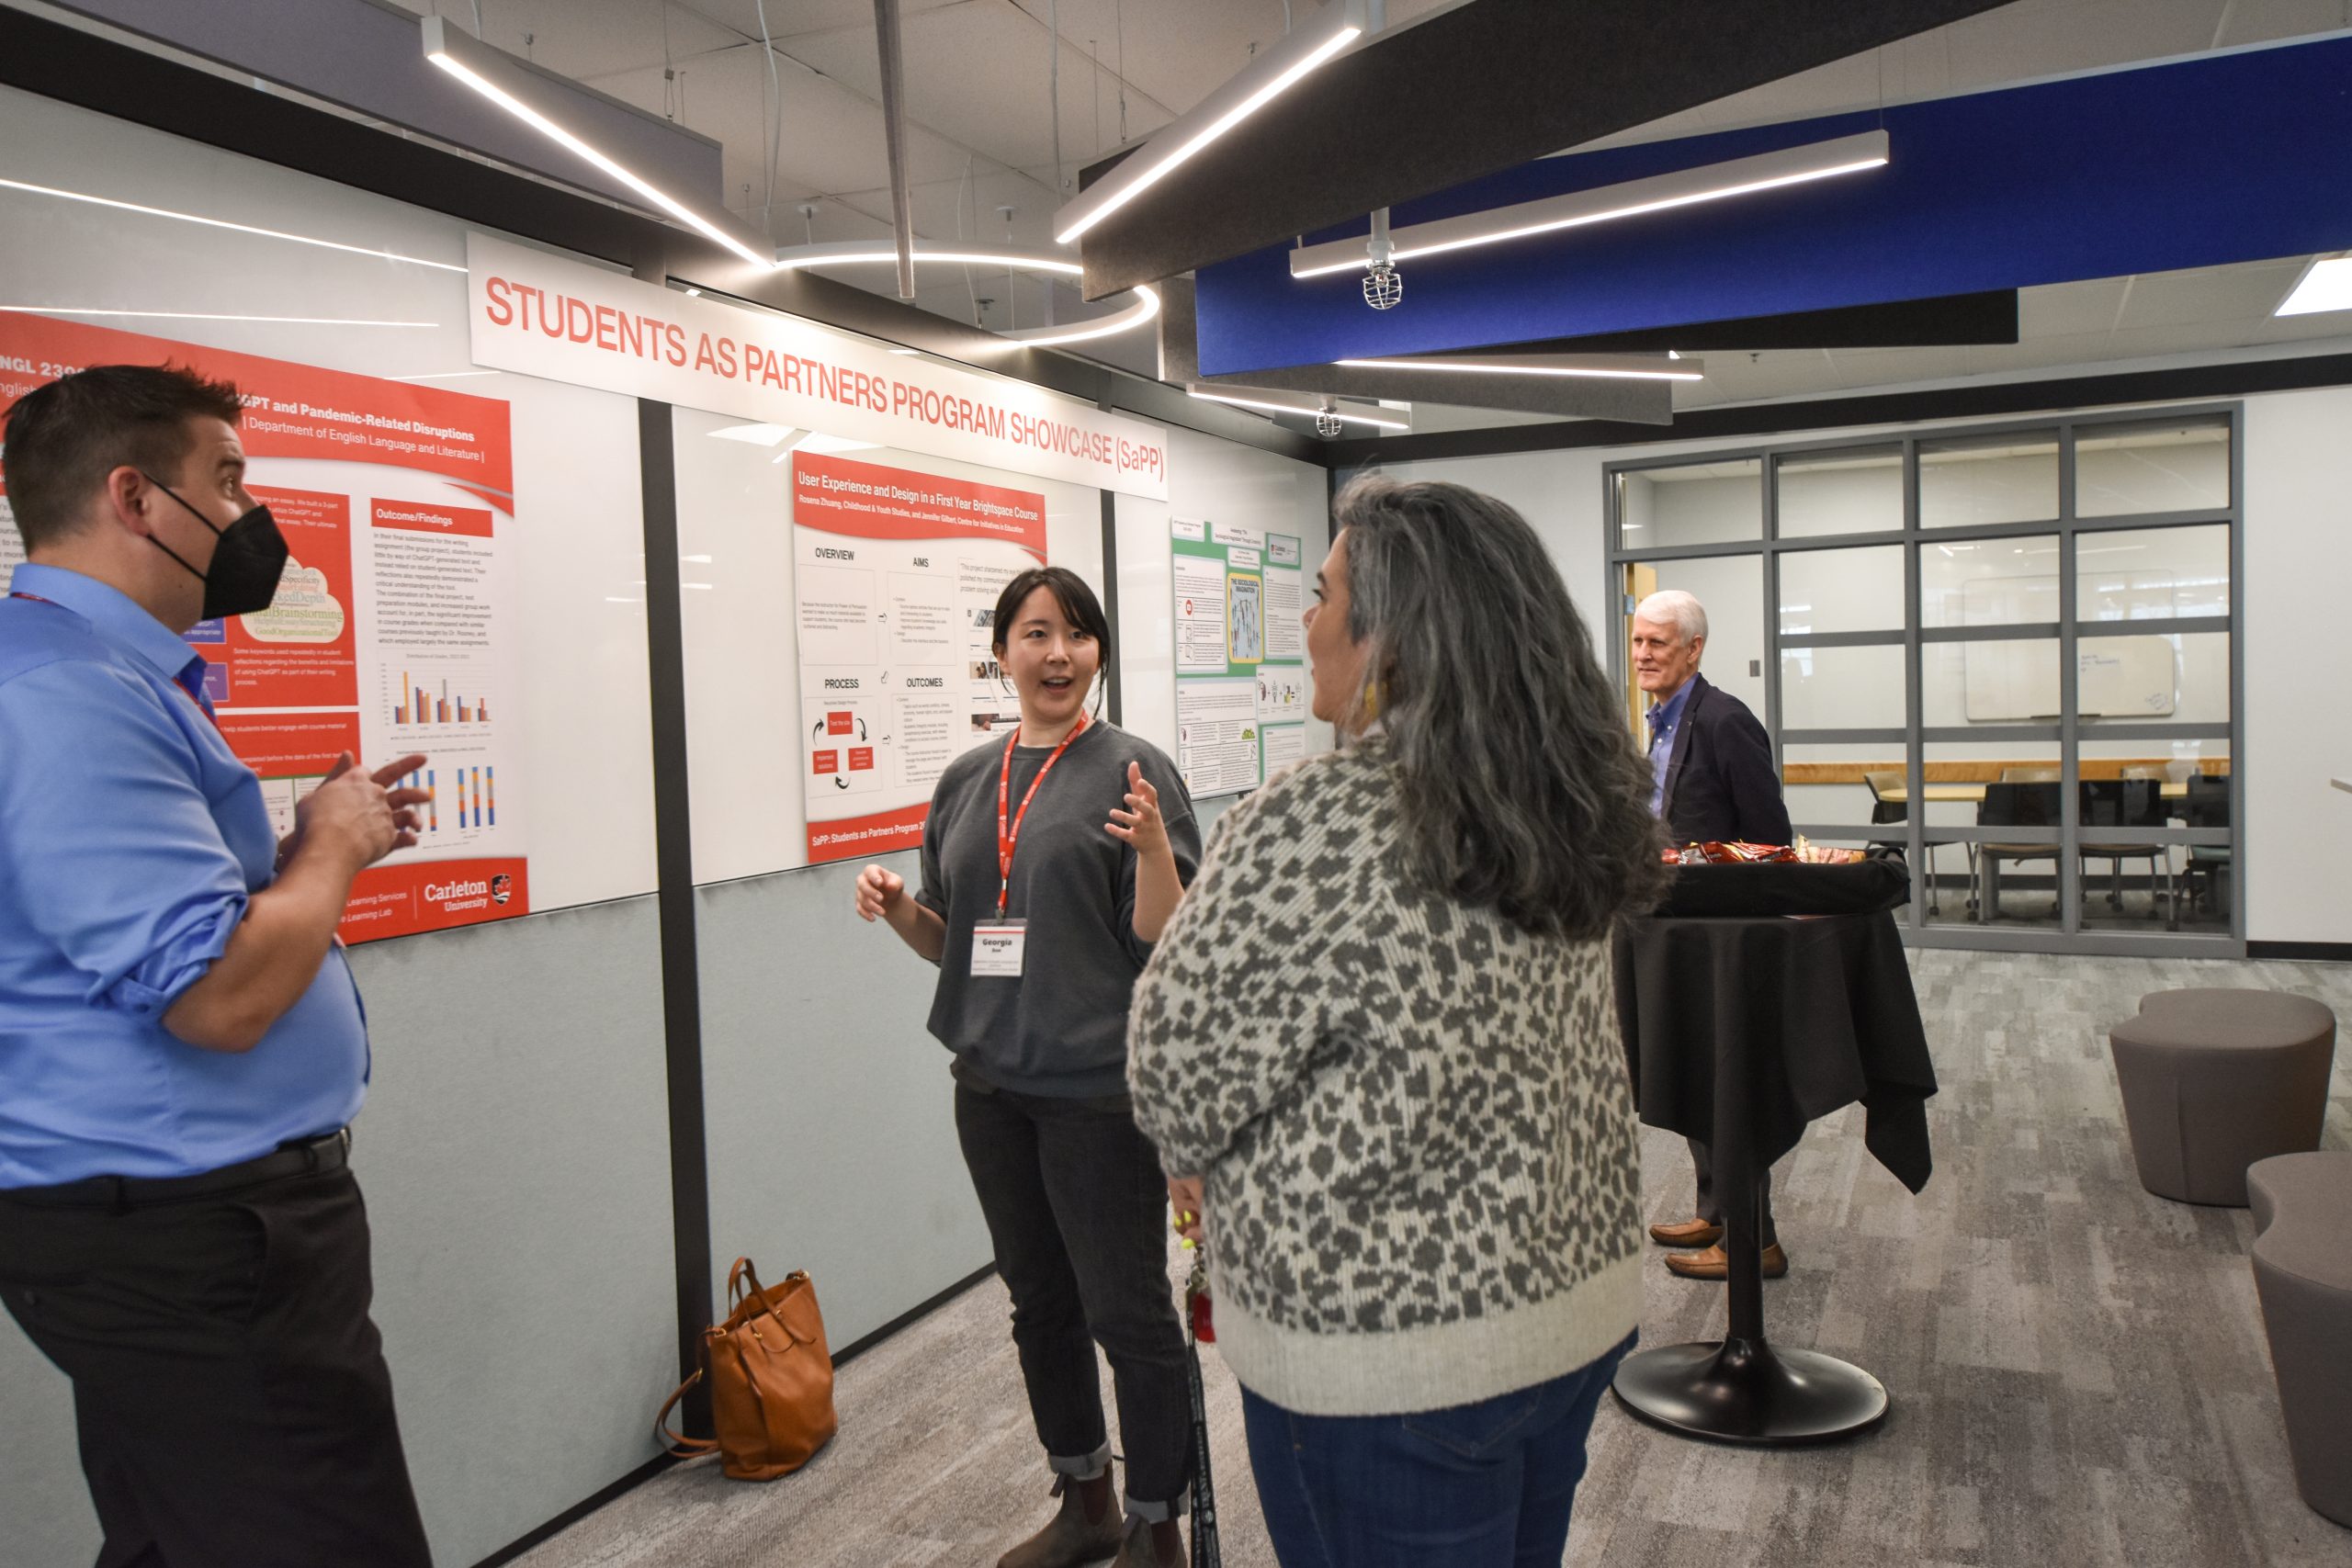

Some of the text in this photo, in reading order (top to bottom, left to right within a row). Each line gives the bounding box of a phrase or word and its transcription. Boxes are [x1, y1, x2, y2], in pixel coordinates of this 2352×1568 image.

[40, 361, 86, 378] 230
[485, 276, 1164, 483] STUDENTS AS PARTNERS PROGRAM SHOWCASE (SaPP)
[273, 401, 298, 414] and
[300, 402, 411, 432] Pandemic-Related
[413, 422, 475, 442] Disruptions
[250, 417, 480, 461] Department of English Language and Literature
[798, 470, 1038, 521] User Experience and Design in a First Year Brightspace Course
[376, 508, 453, 527] Outcome/Findings
[843, 501, 871, 513] Childhood
[876, 505, 891, 514] Youth
[911, 511, 921, 519] and
[1005, 524, 1024, 534] Education
[815, 547, 854, 560] OVERVIEW
[913, 557, 929, 568] AIMS
[825, 678, 859, 690] PROCESS
[907, 678, 943, 688] OUTCOMES
[812, 834, 831, 847] SaPP:
[831, 831, 859, 843] Students
[860, 830, 867, 839] as
[869, 827, 894, 838] Partners
[895, 823, 919, 834] Program
[347, 891, 408, 907] Learning Services
[424, 880, 487, 902] Carleton
[445, 897, 488, 912] University
[347, 908, 392, 922] Learning Lab
[983, 939, 1012, 947] Georgia
